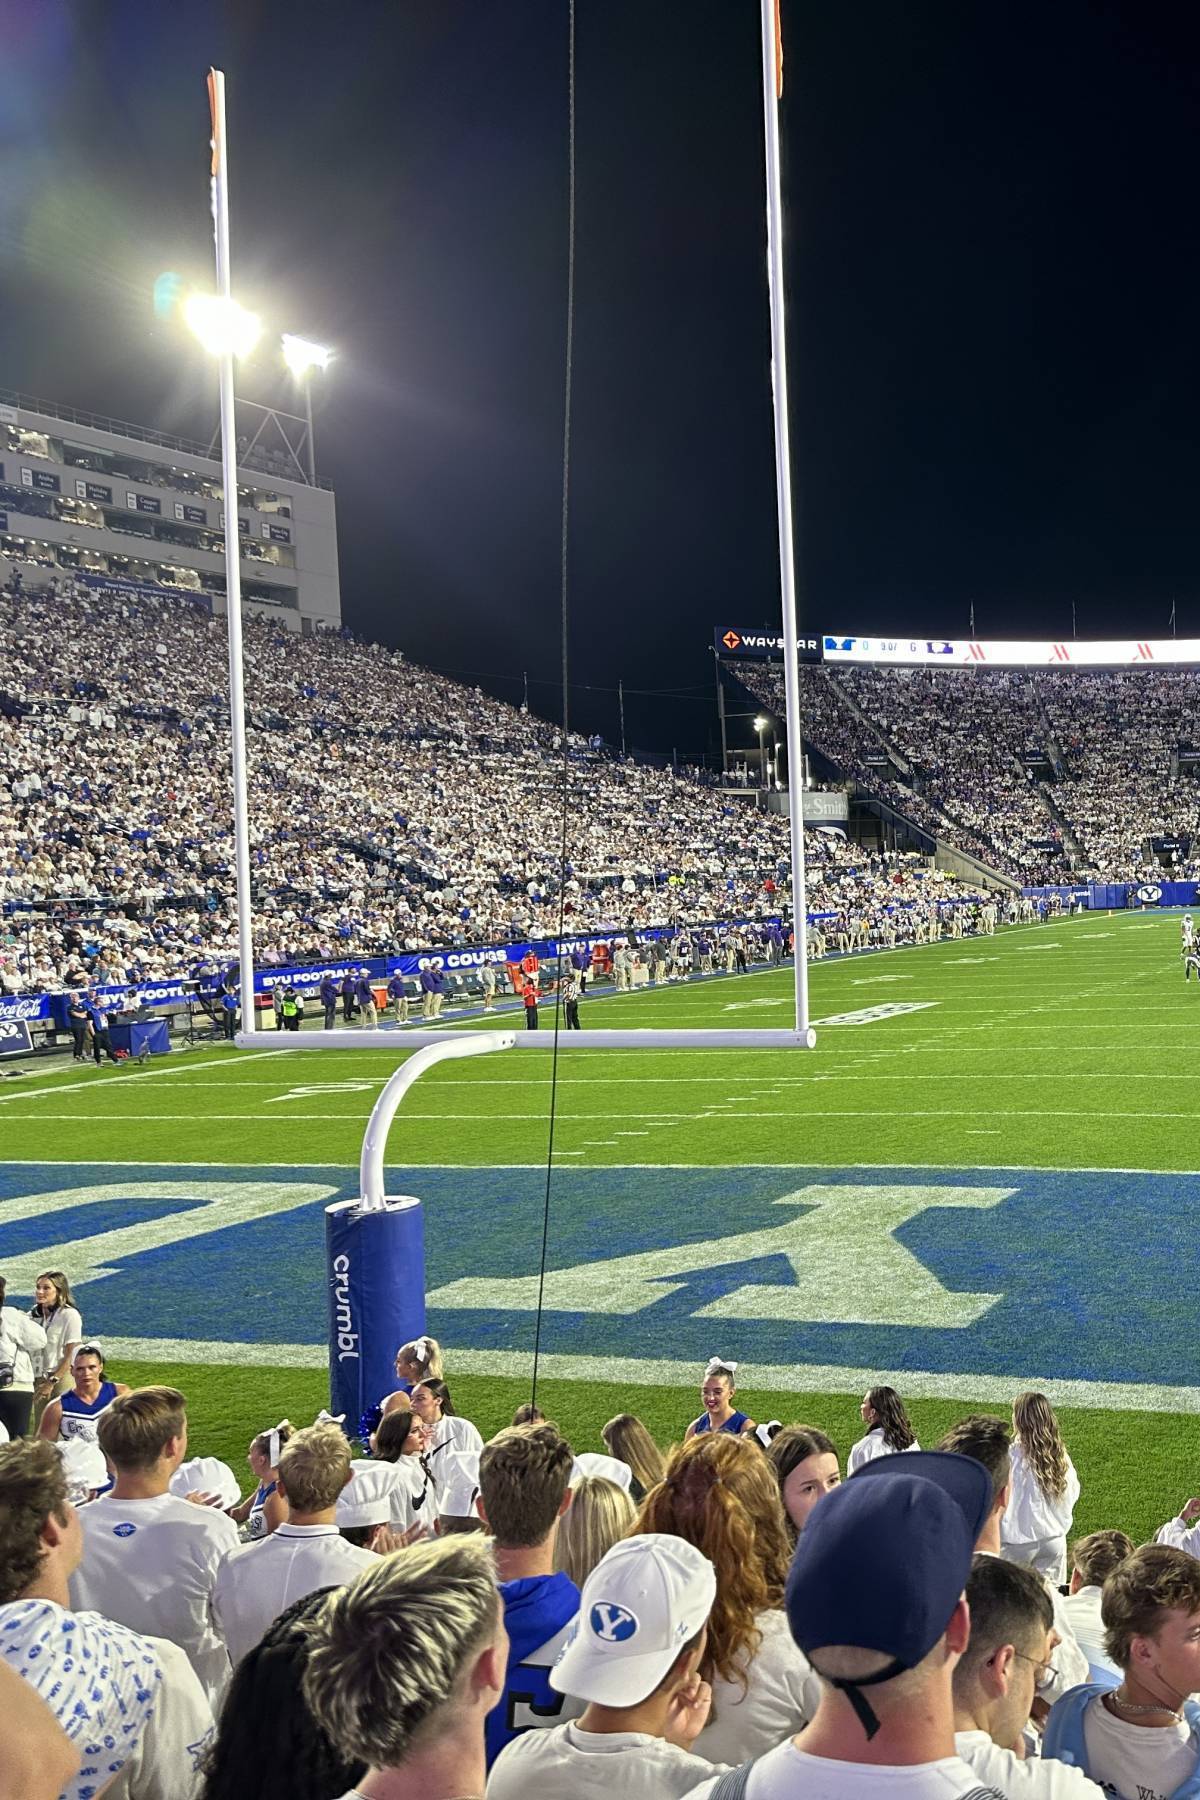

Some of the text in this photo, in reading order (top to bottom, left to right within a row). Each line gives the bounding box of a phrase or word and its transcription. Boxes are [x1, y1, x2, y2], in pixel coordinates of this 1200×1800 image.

[741, 636, 817, 650] WAYSAR
[1141, 888, 1158, 900] Y
[447, 949, 508, 968] COUGS
[262, 974, 291, 987] BYU
[303, 987, 315, 997] 30
[333, 1253, 359, 1363] crumbl
[595, 1604, 632, 1640] Y
